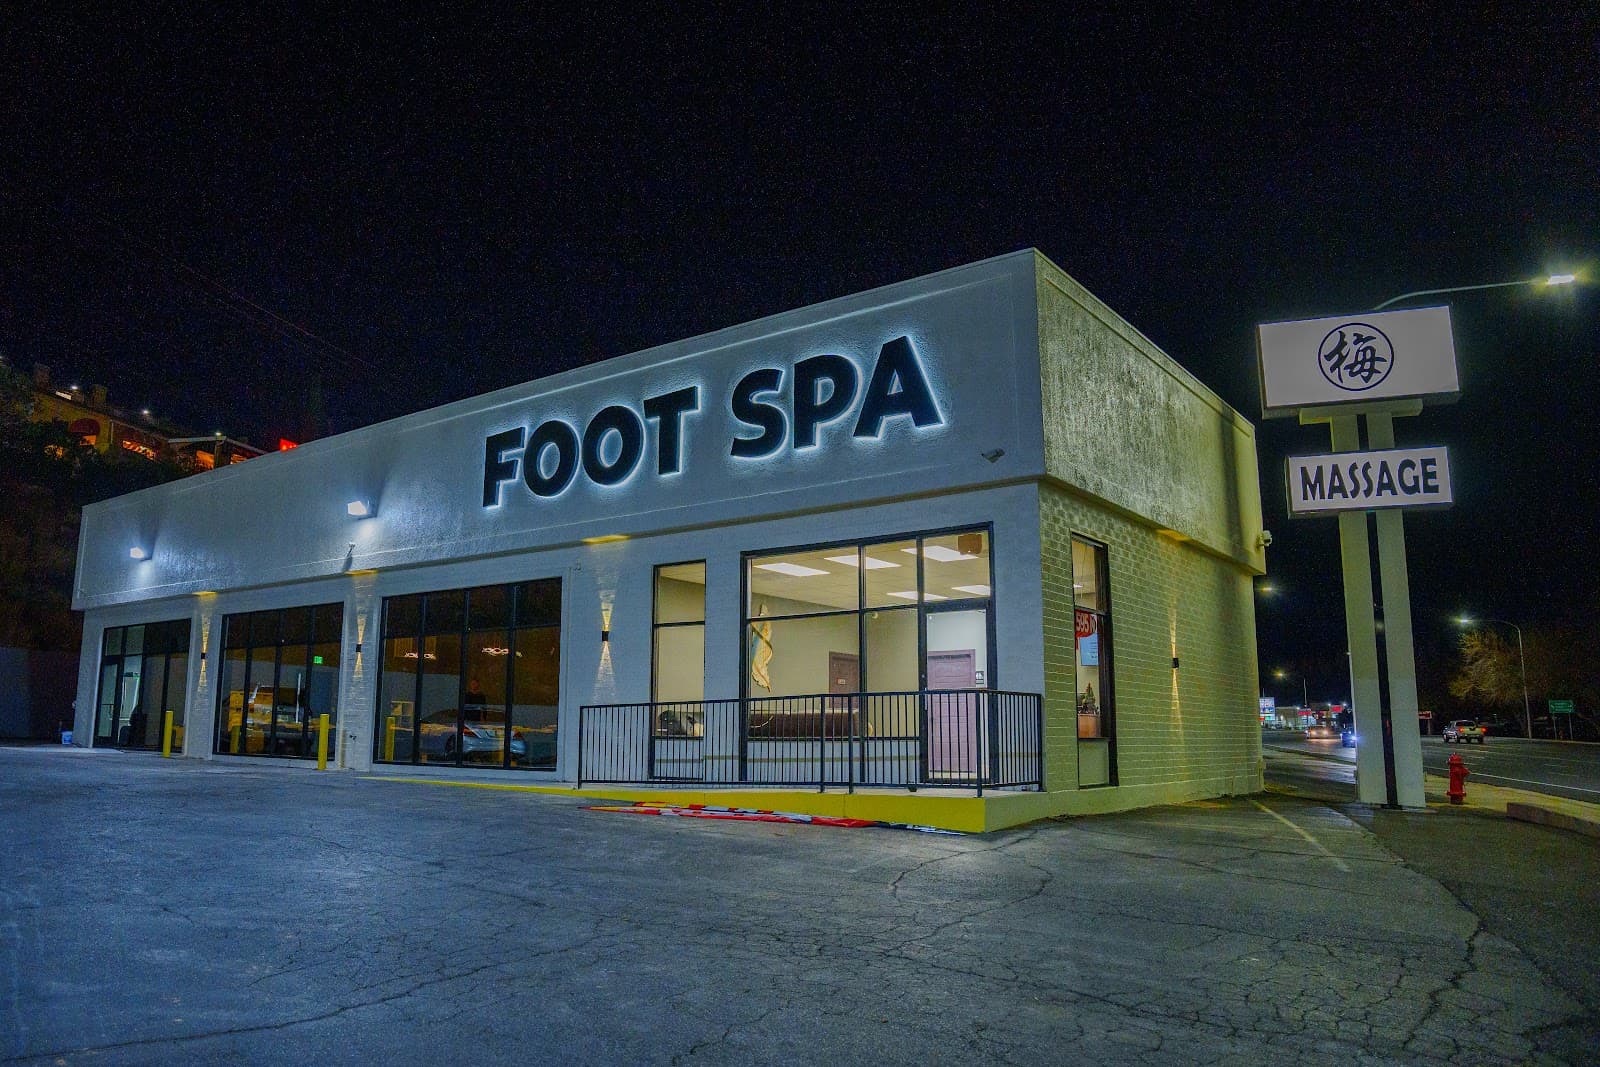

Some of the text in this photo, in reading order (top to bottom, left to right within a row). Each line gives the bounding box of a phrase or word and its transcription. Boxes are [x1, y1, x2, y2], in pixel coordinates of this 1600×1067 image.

[482, 335, 946, 510] FOOT SPA
[1300, 458, 1440, 500] MASSAGE
